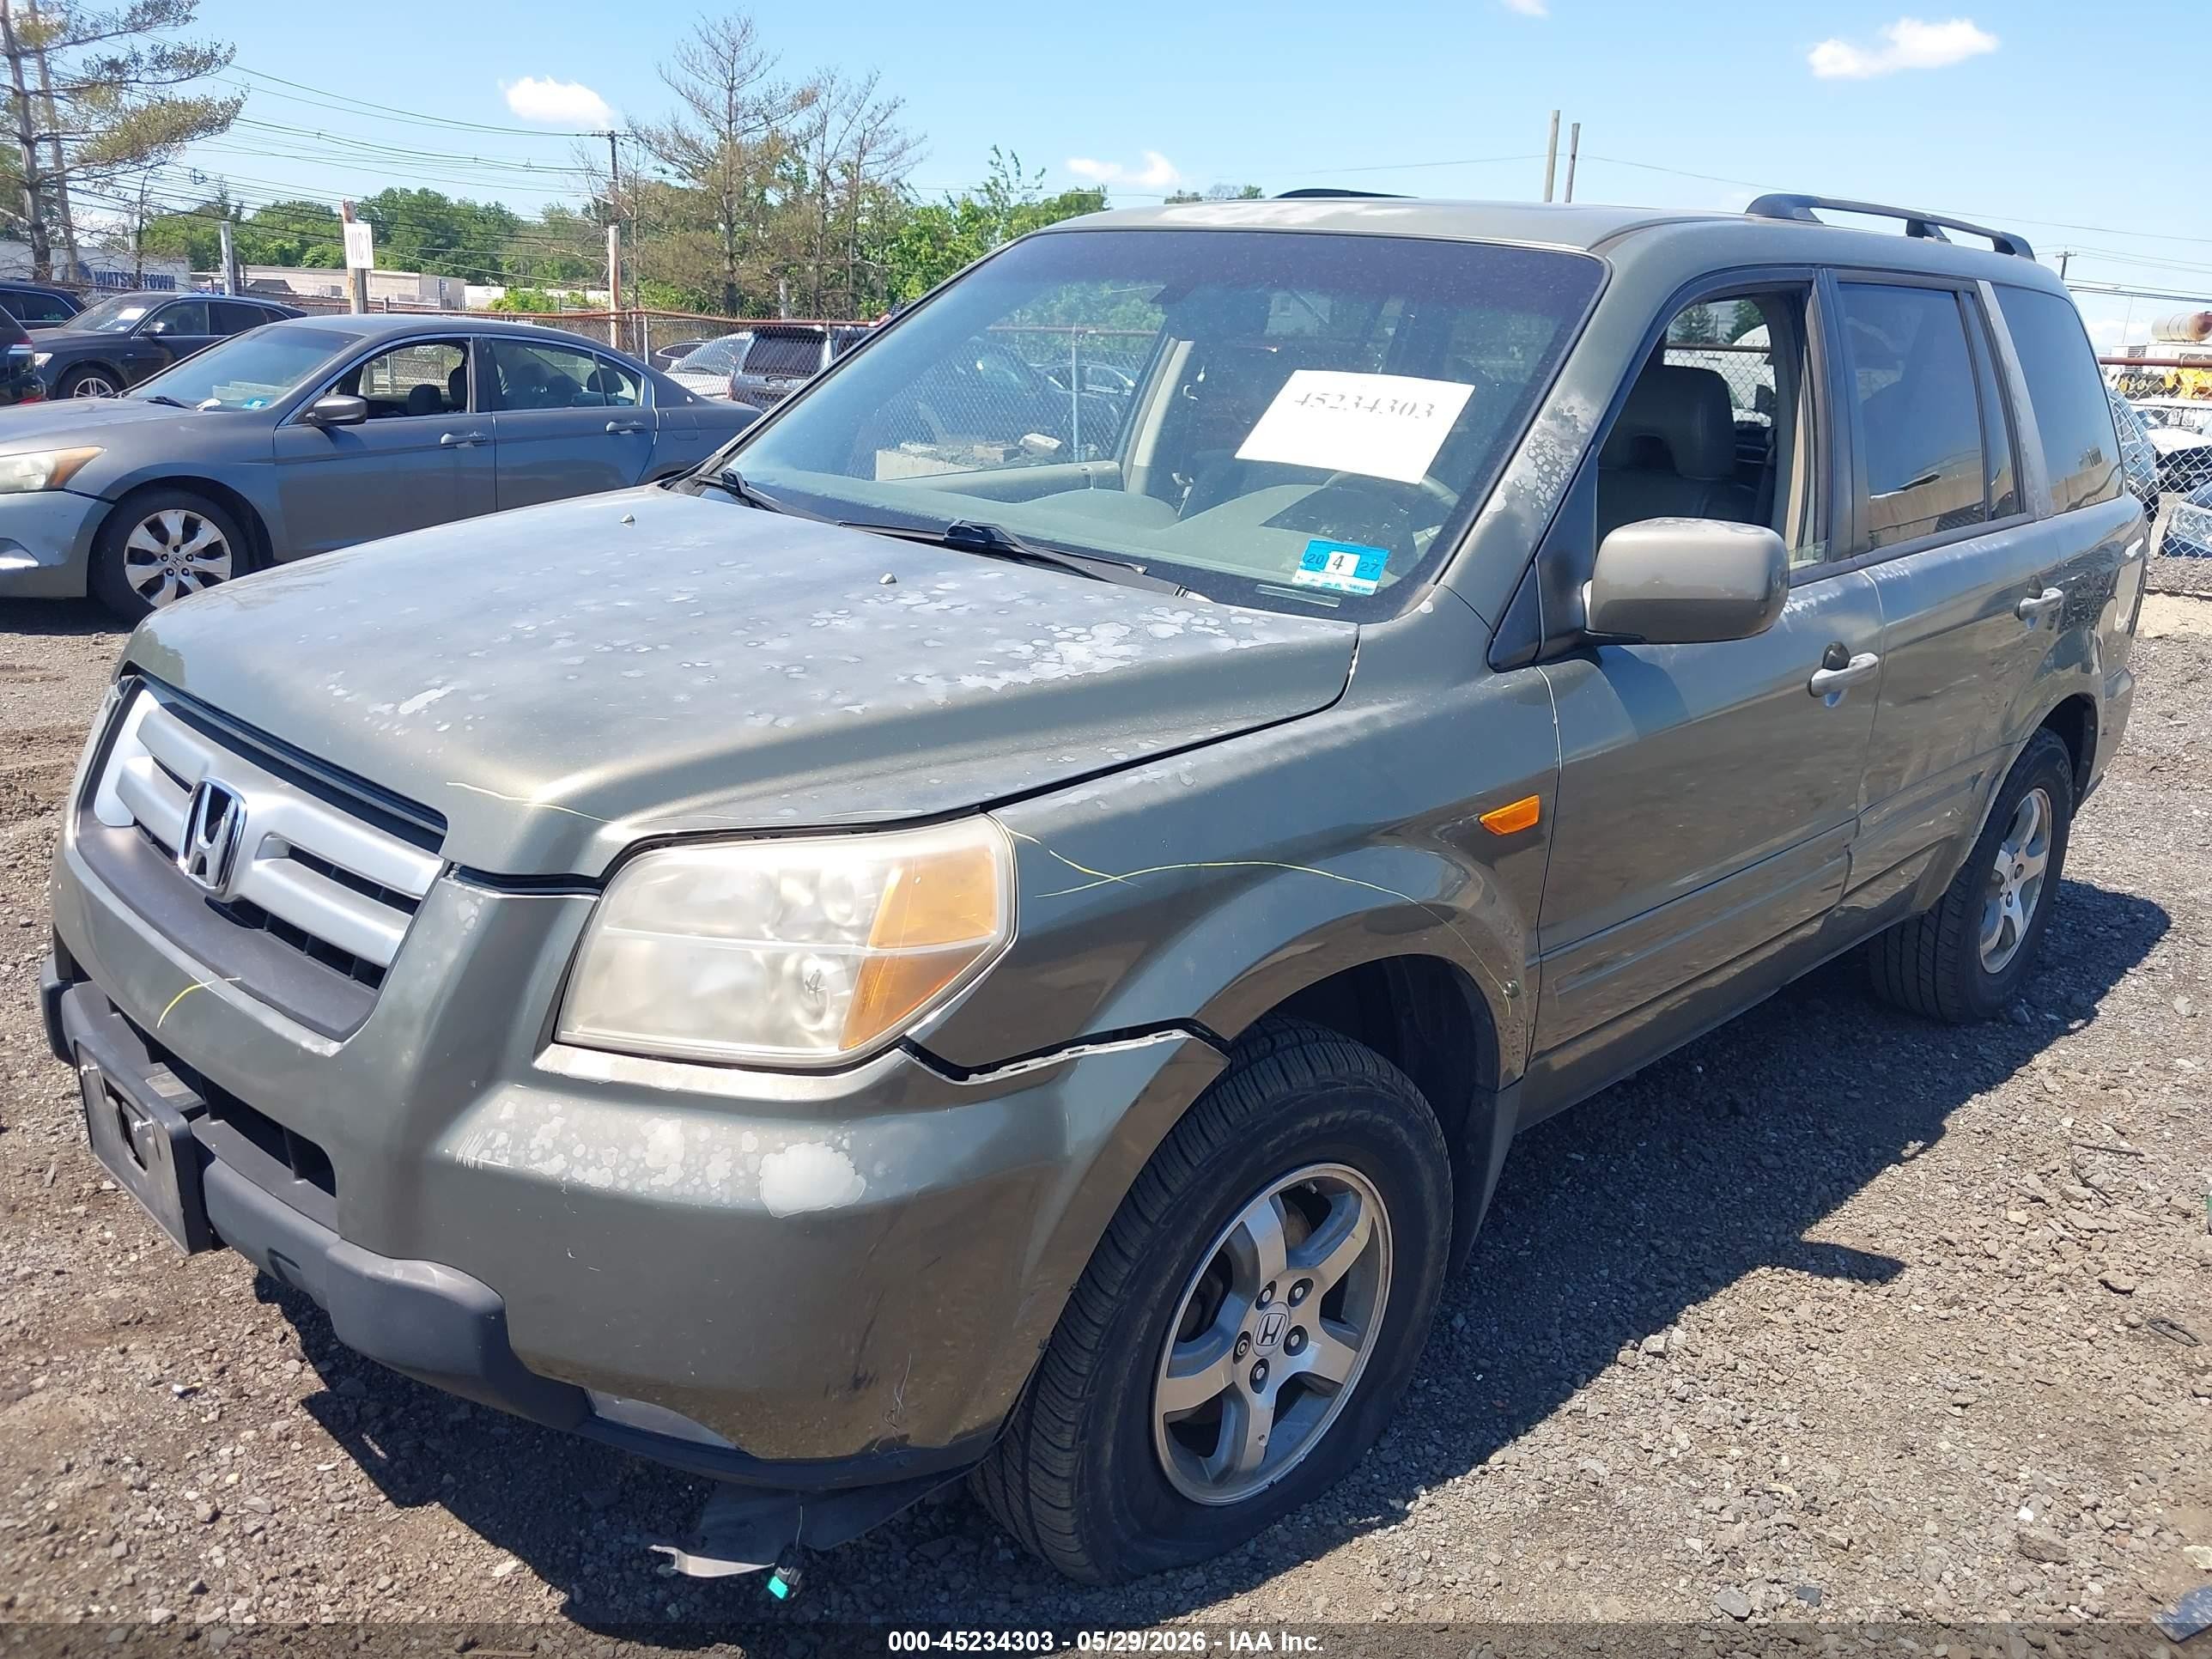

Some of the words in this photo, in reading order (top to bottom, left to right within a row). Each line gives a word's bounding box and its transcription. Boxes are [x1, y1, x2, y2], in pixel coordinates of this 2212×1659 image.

[1294, 392, 1435, 419] 45234303
[1306, 553, 1325, 564] 20
[1333, 554, 1345, 570] 4
[1359, 562, 1380, 573] 27
